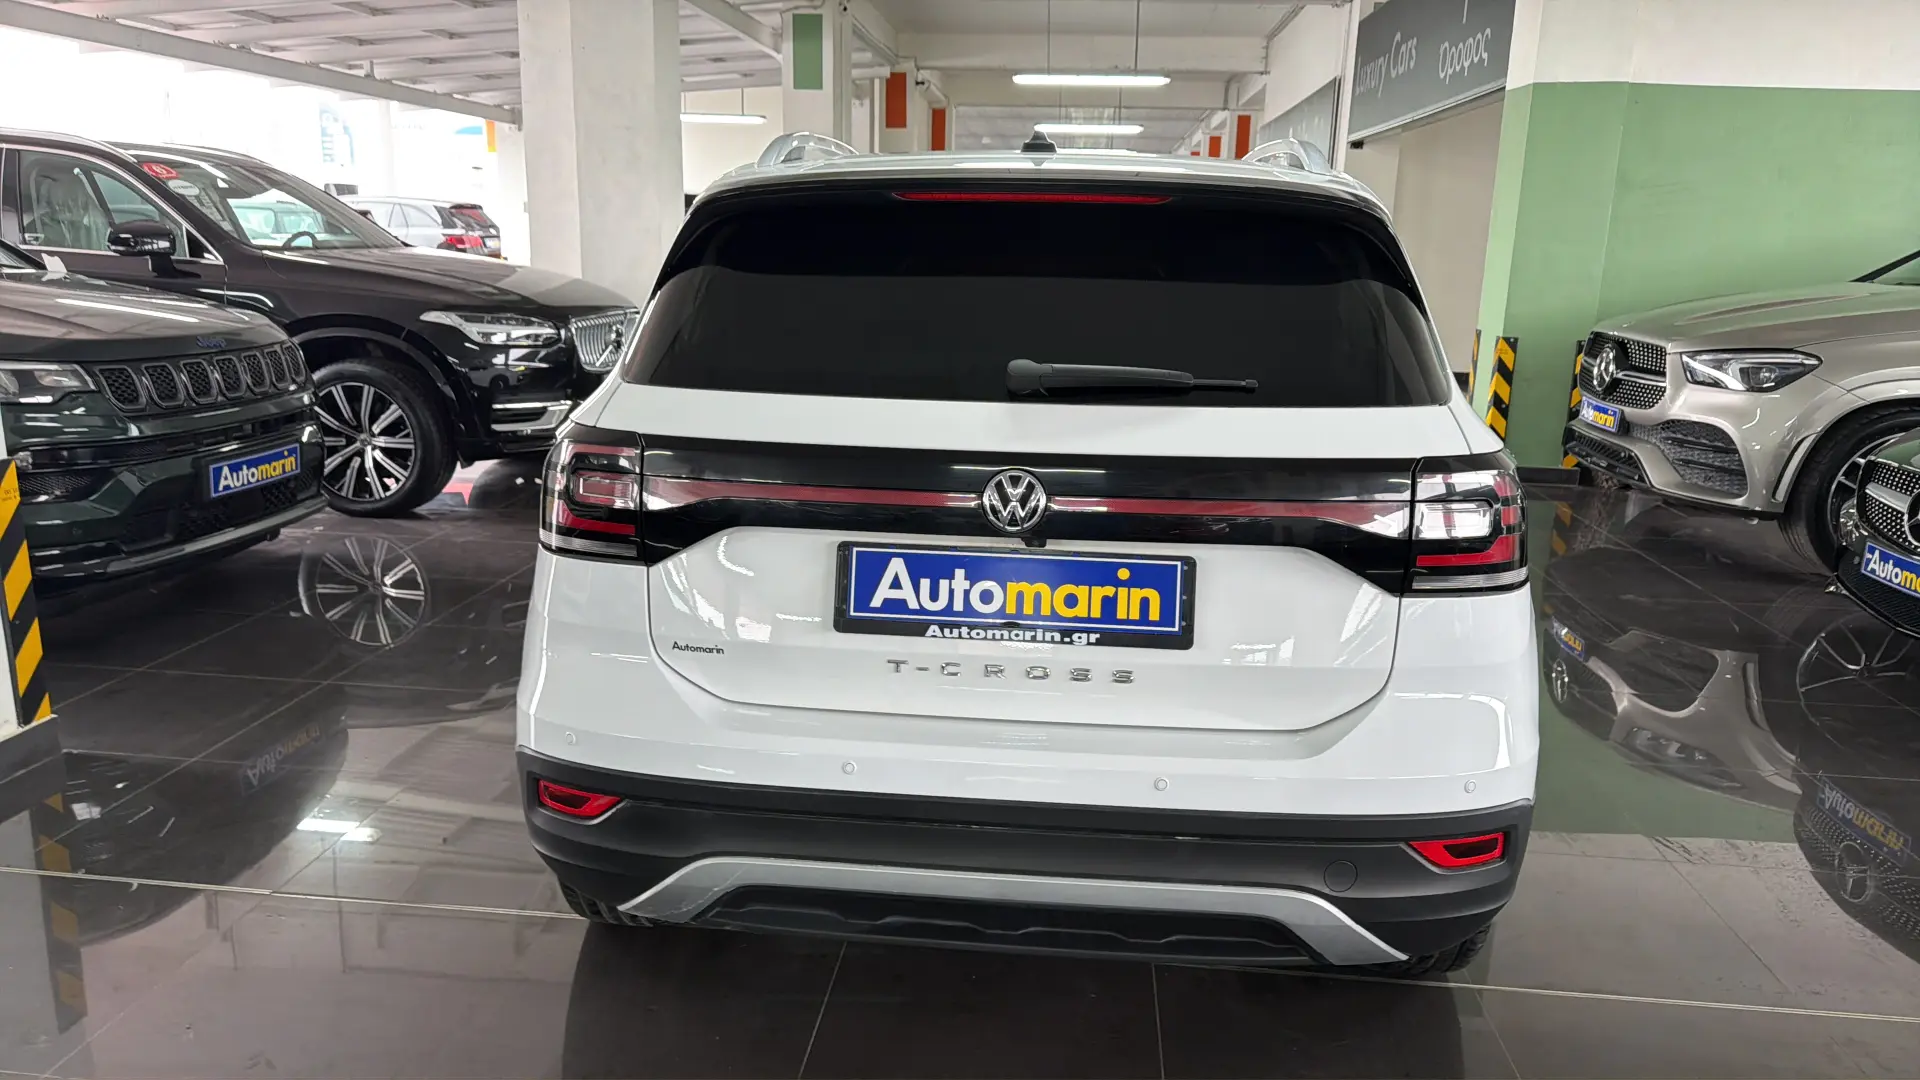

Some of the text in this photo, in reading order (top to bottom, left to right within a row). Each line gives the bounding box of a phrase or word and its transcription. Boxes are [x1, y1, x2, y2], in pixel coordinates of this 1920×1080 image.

[1354, 31, 1417, 97] Luxury Cars
[218, 450, 297, 491] Automarin
[869, 557, 1161, 621] Automarin
[672, 641, 725, 654] Automarin
[925, 625, 1100, 645] Automarin.gr
[887, 659, 1135, 684] T-CROSS
